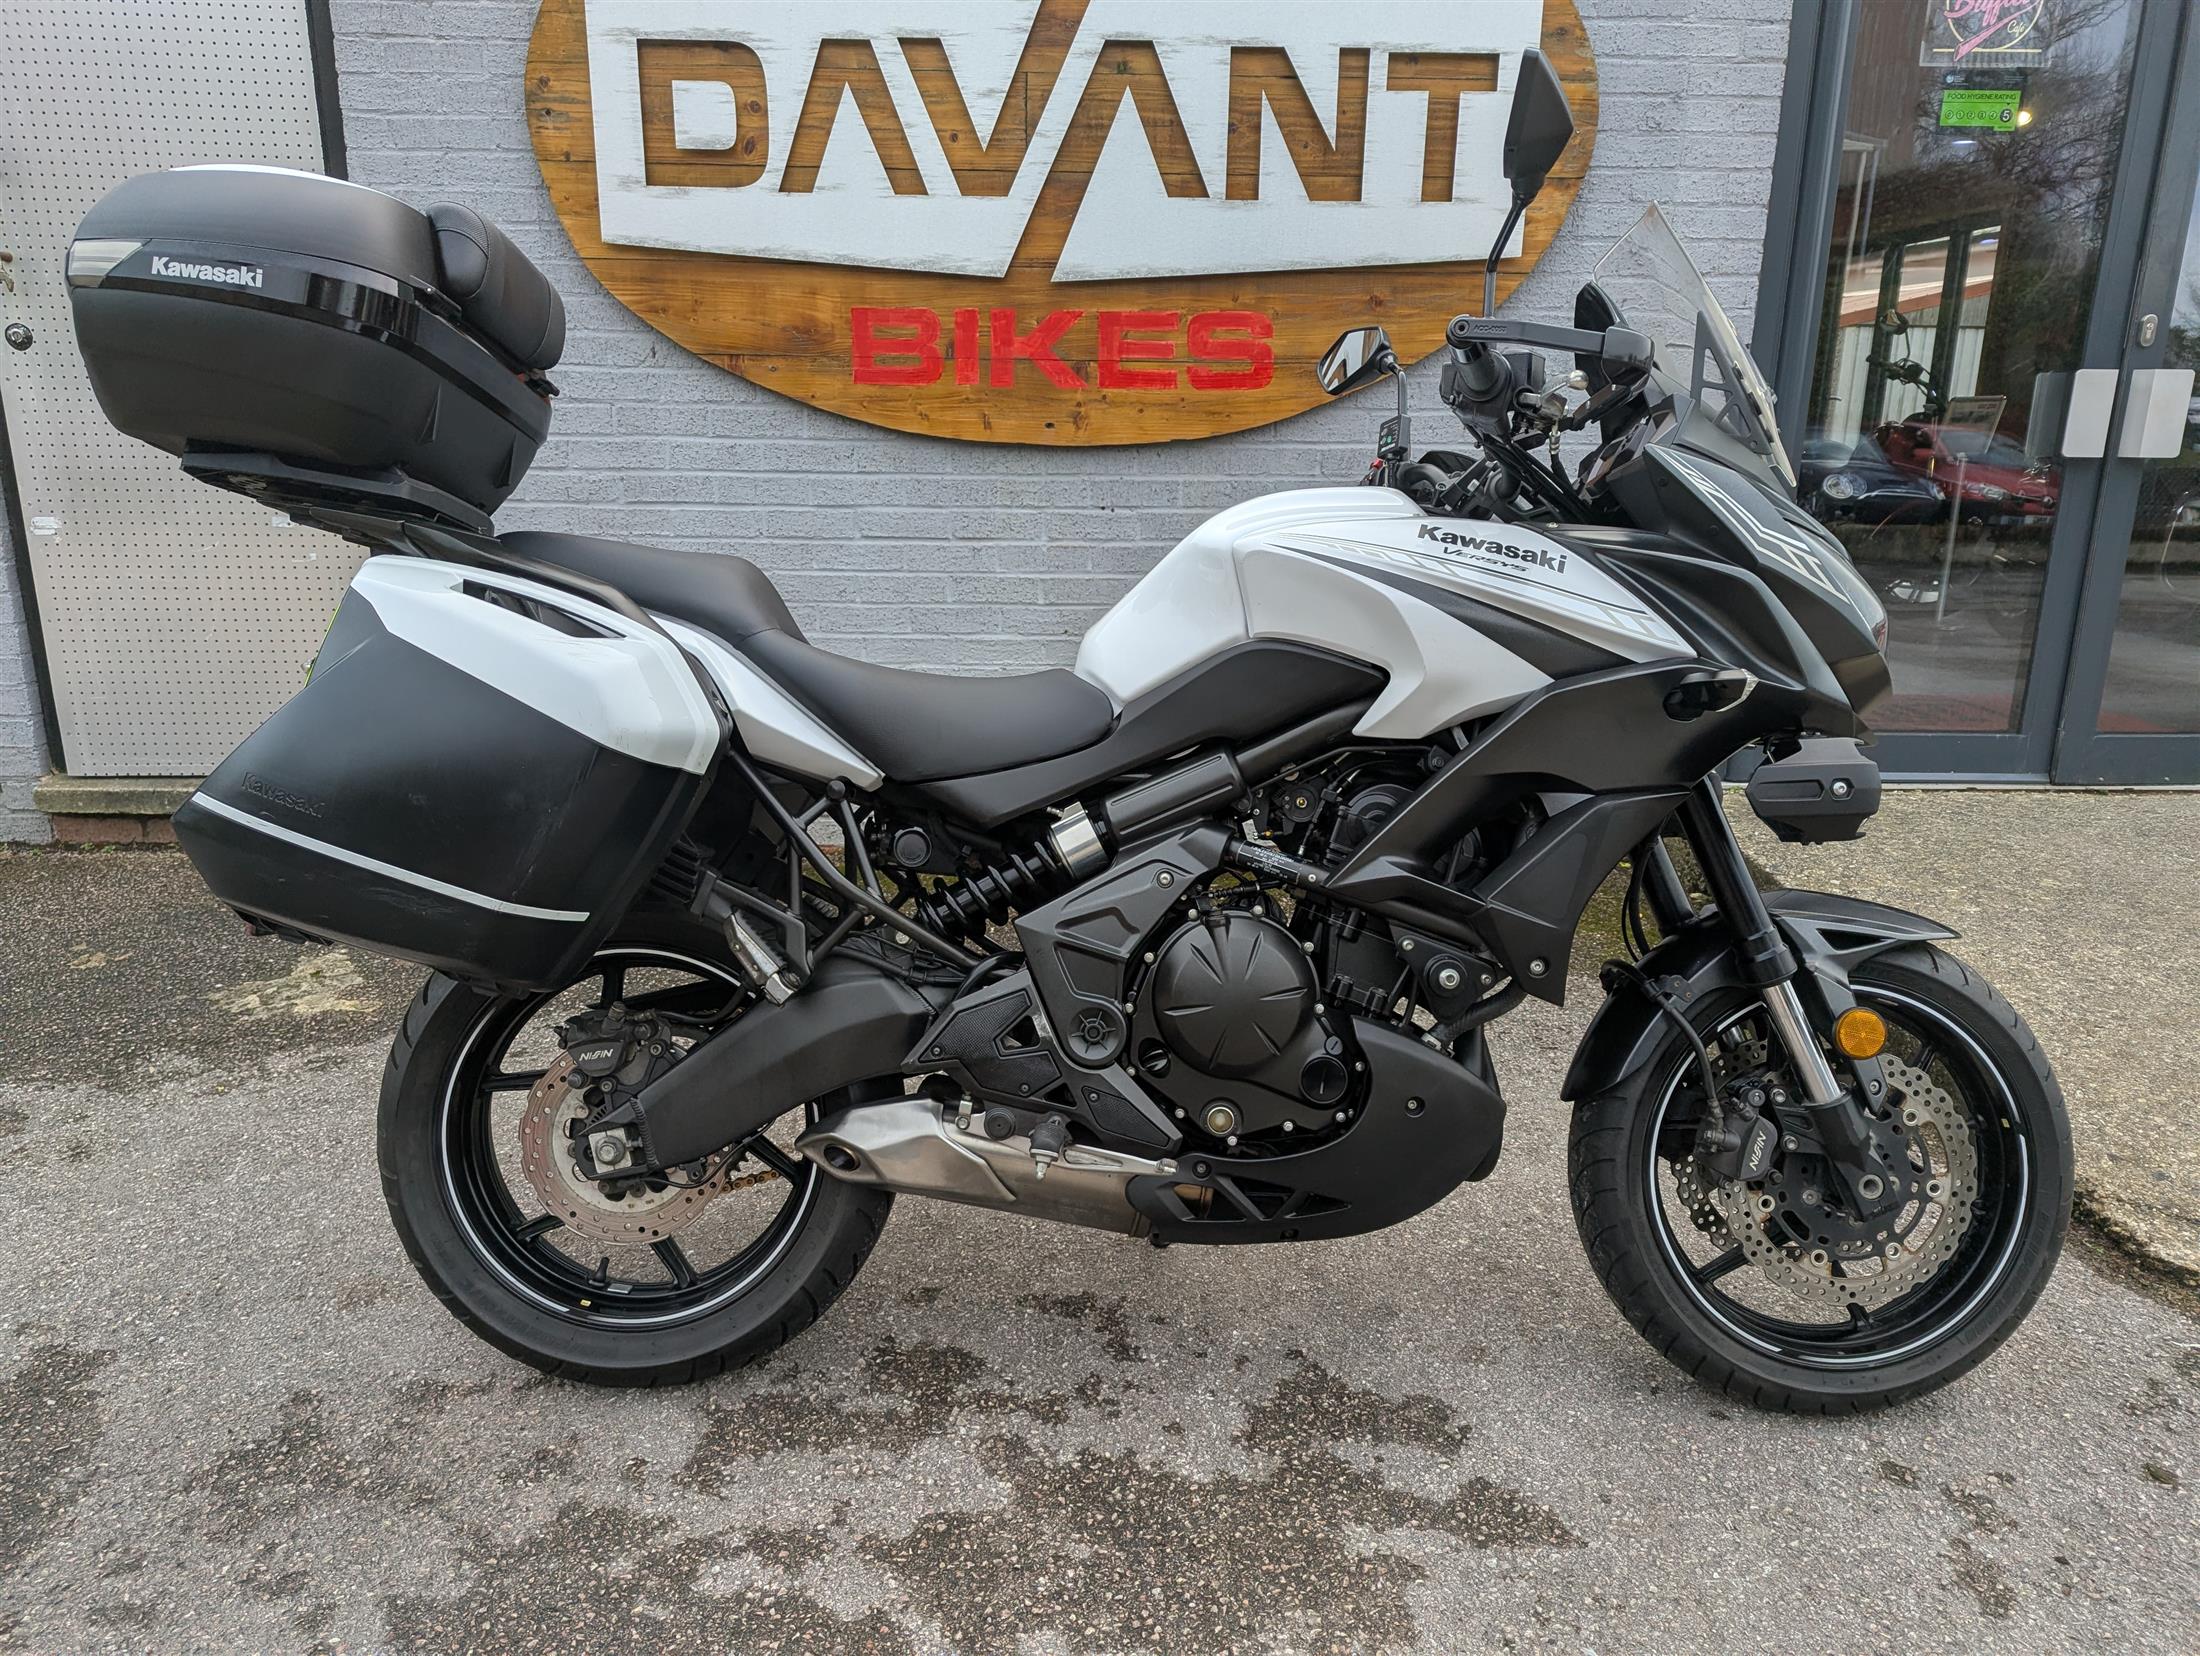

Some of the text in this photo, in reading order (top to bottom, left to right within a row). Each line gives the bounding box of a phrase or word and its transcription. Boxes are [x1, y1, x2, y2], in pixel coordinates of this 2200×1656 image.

[637, 36, 1499, 202] DAVANT
[2002, 110, 2010, 122] 5
[151, 256, 263, 288] Kawasaki
[849, 306, 1275, 390] BIKES
[1417, 524, 1568, 574] Kawasaki
[1443, 547, 1529, 572] VERSYS
[241, 771, 326, 819] Kawasaki
